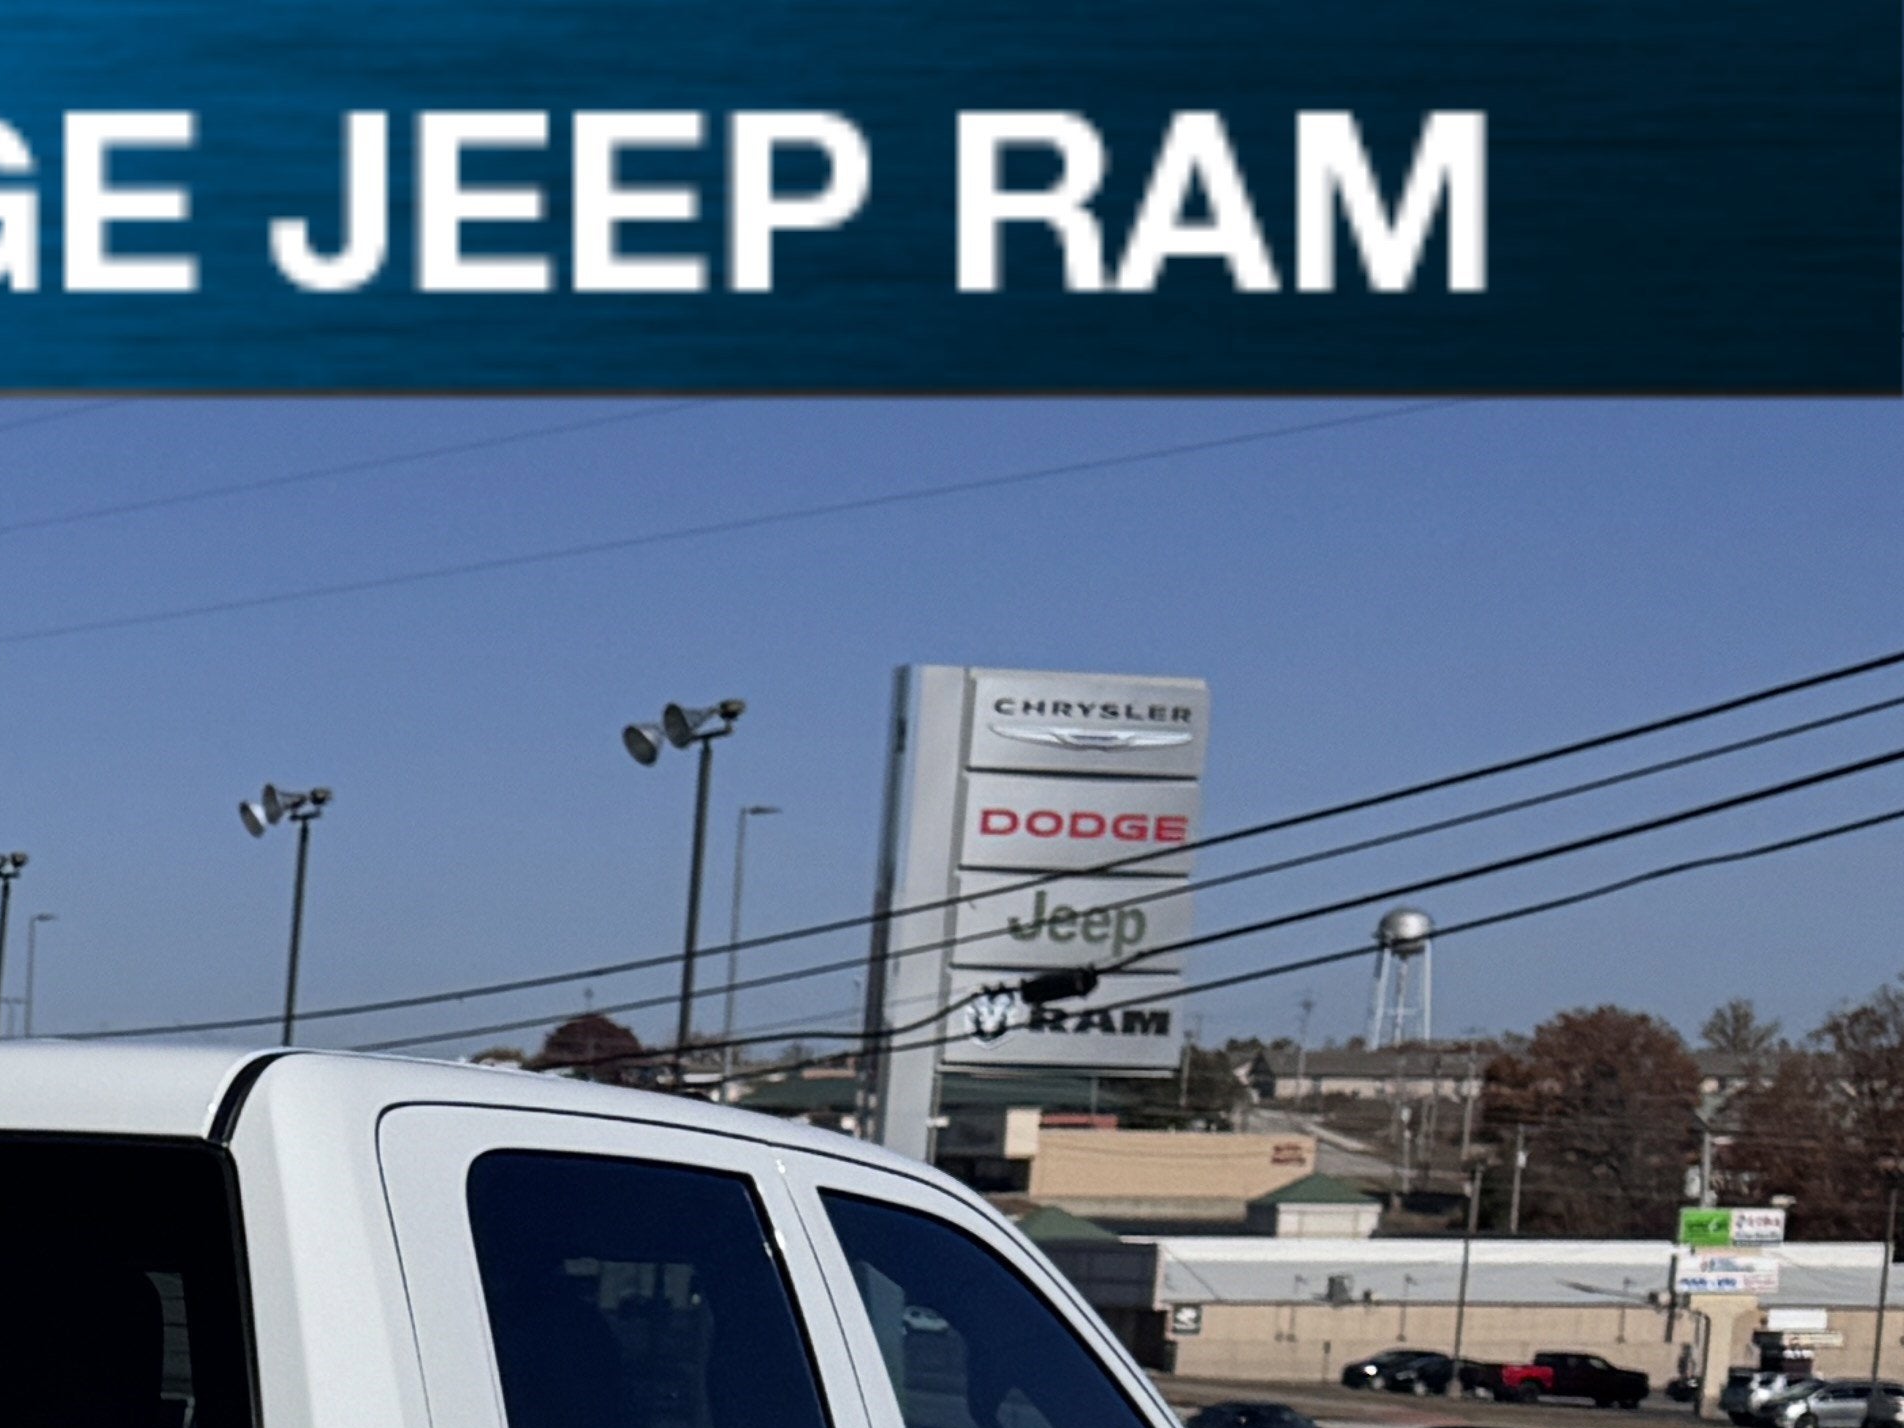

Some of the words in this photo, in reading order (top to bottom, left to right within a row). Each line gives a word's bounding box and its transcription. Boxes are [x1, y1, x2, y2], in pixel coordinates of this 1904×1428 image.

[993, 696, 1192, 724] CHRYSLER
[979, 807, 1190, 844] DODGE
[1007, 889, 1148, 957] Jeep
[1028, 1006, 1171, 1036] RAM
